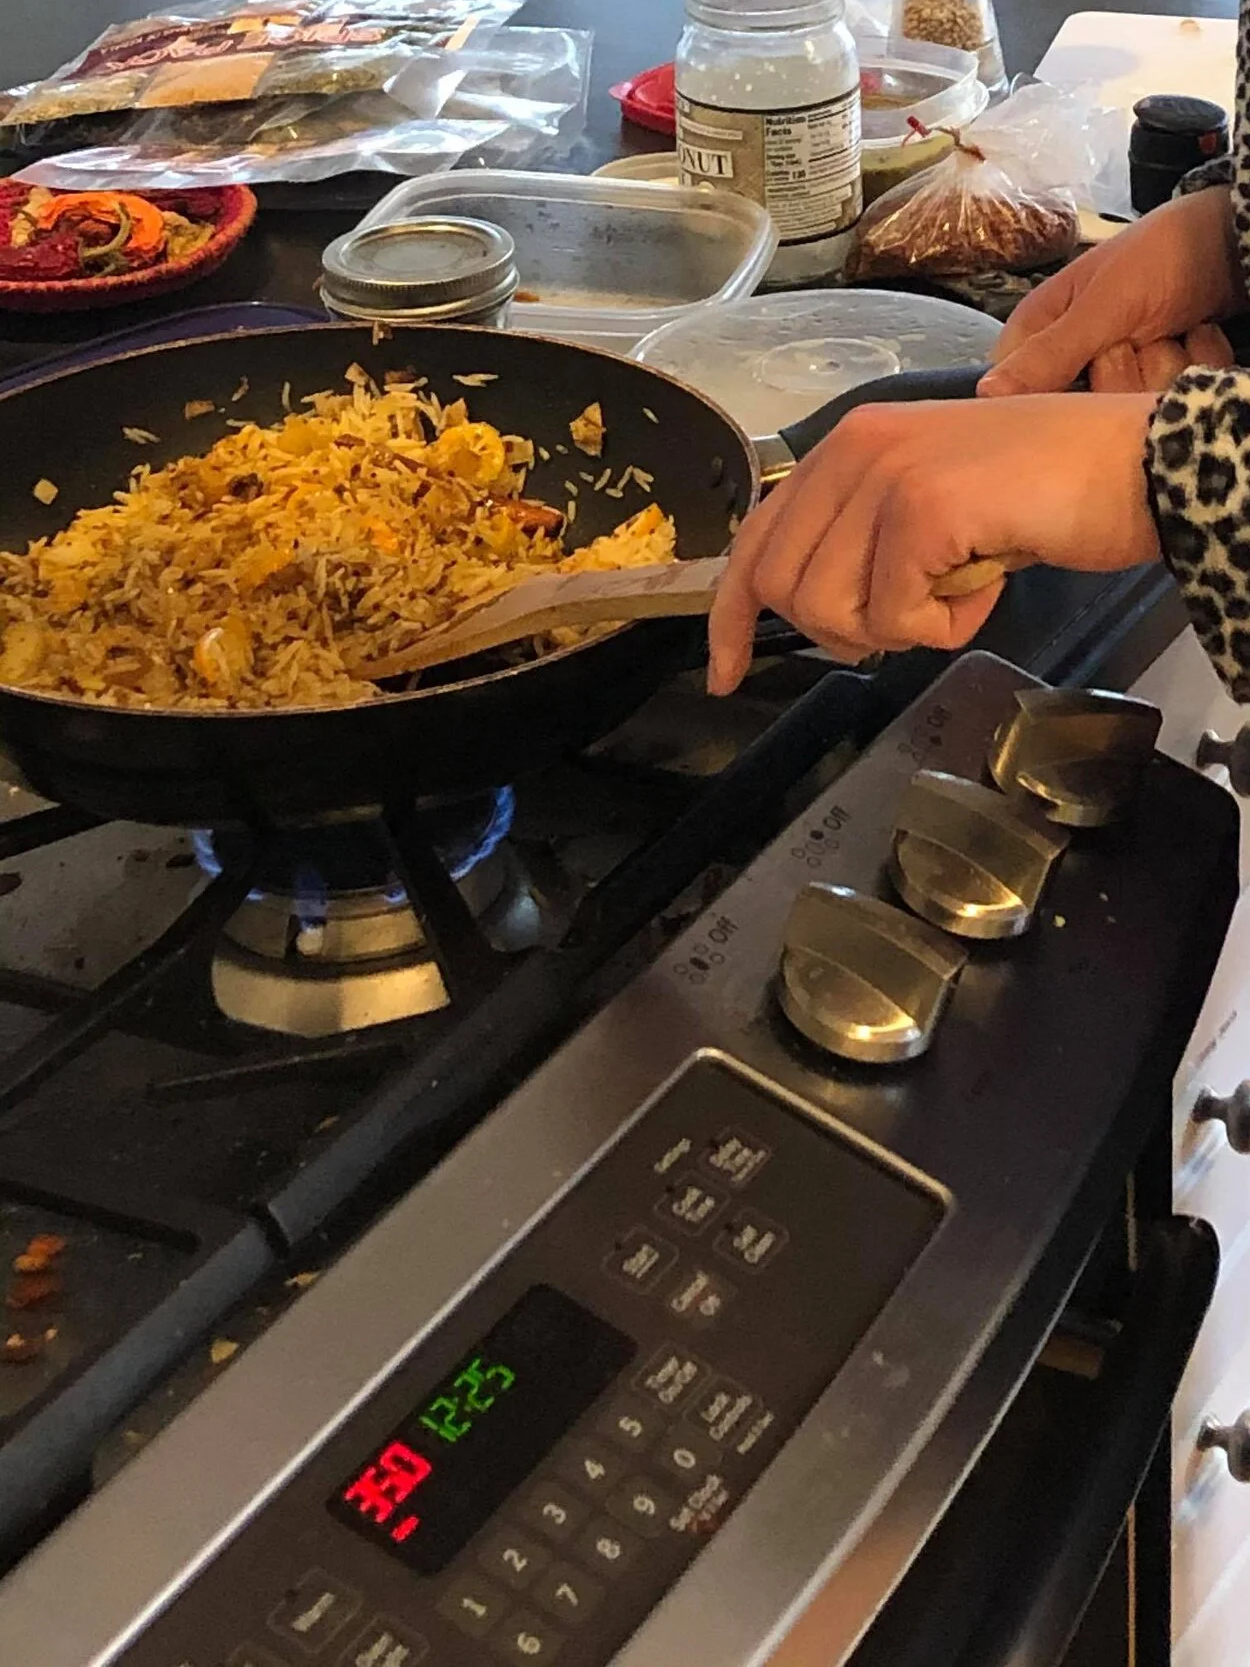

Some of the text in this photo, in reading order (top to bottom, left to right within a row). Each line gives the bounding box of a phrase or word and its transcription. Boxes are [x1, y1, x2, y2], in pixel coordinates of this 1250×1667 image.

[823, 805, 852, 831] Off
[709, 915, 738, 943] Off
[618, 1416, 642, 1437] 5
[583, 1458, 606, 1481] 4
[673, 1448, 695, 1468] 0
[345, 1441, 431, 1523] 350
[544, 1501, 567, 1524] 3
[633, 1495, 655, 1514] 9
[503, 1548, 528, 1573] 2
[597, 1537, 621, 1561] 8
[461, 1596, 487, 1618] 1
[556, 1584, 580, 1608] 7
[517, 1632, 541, 1655] 6
